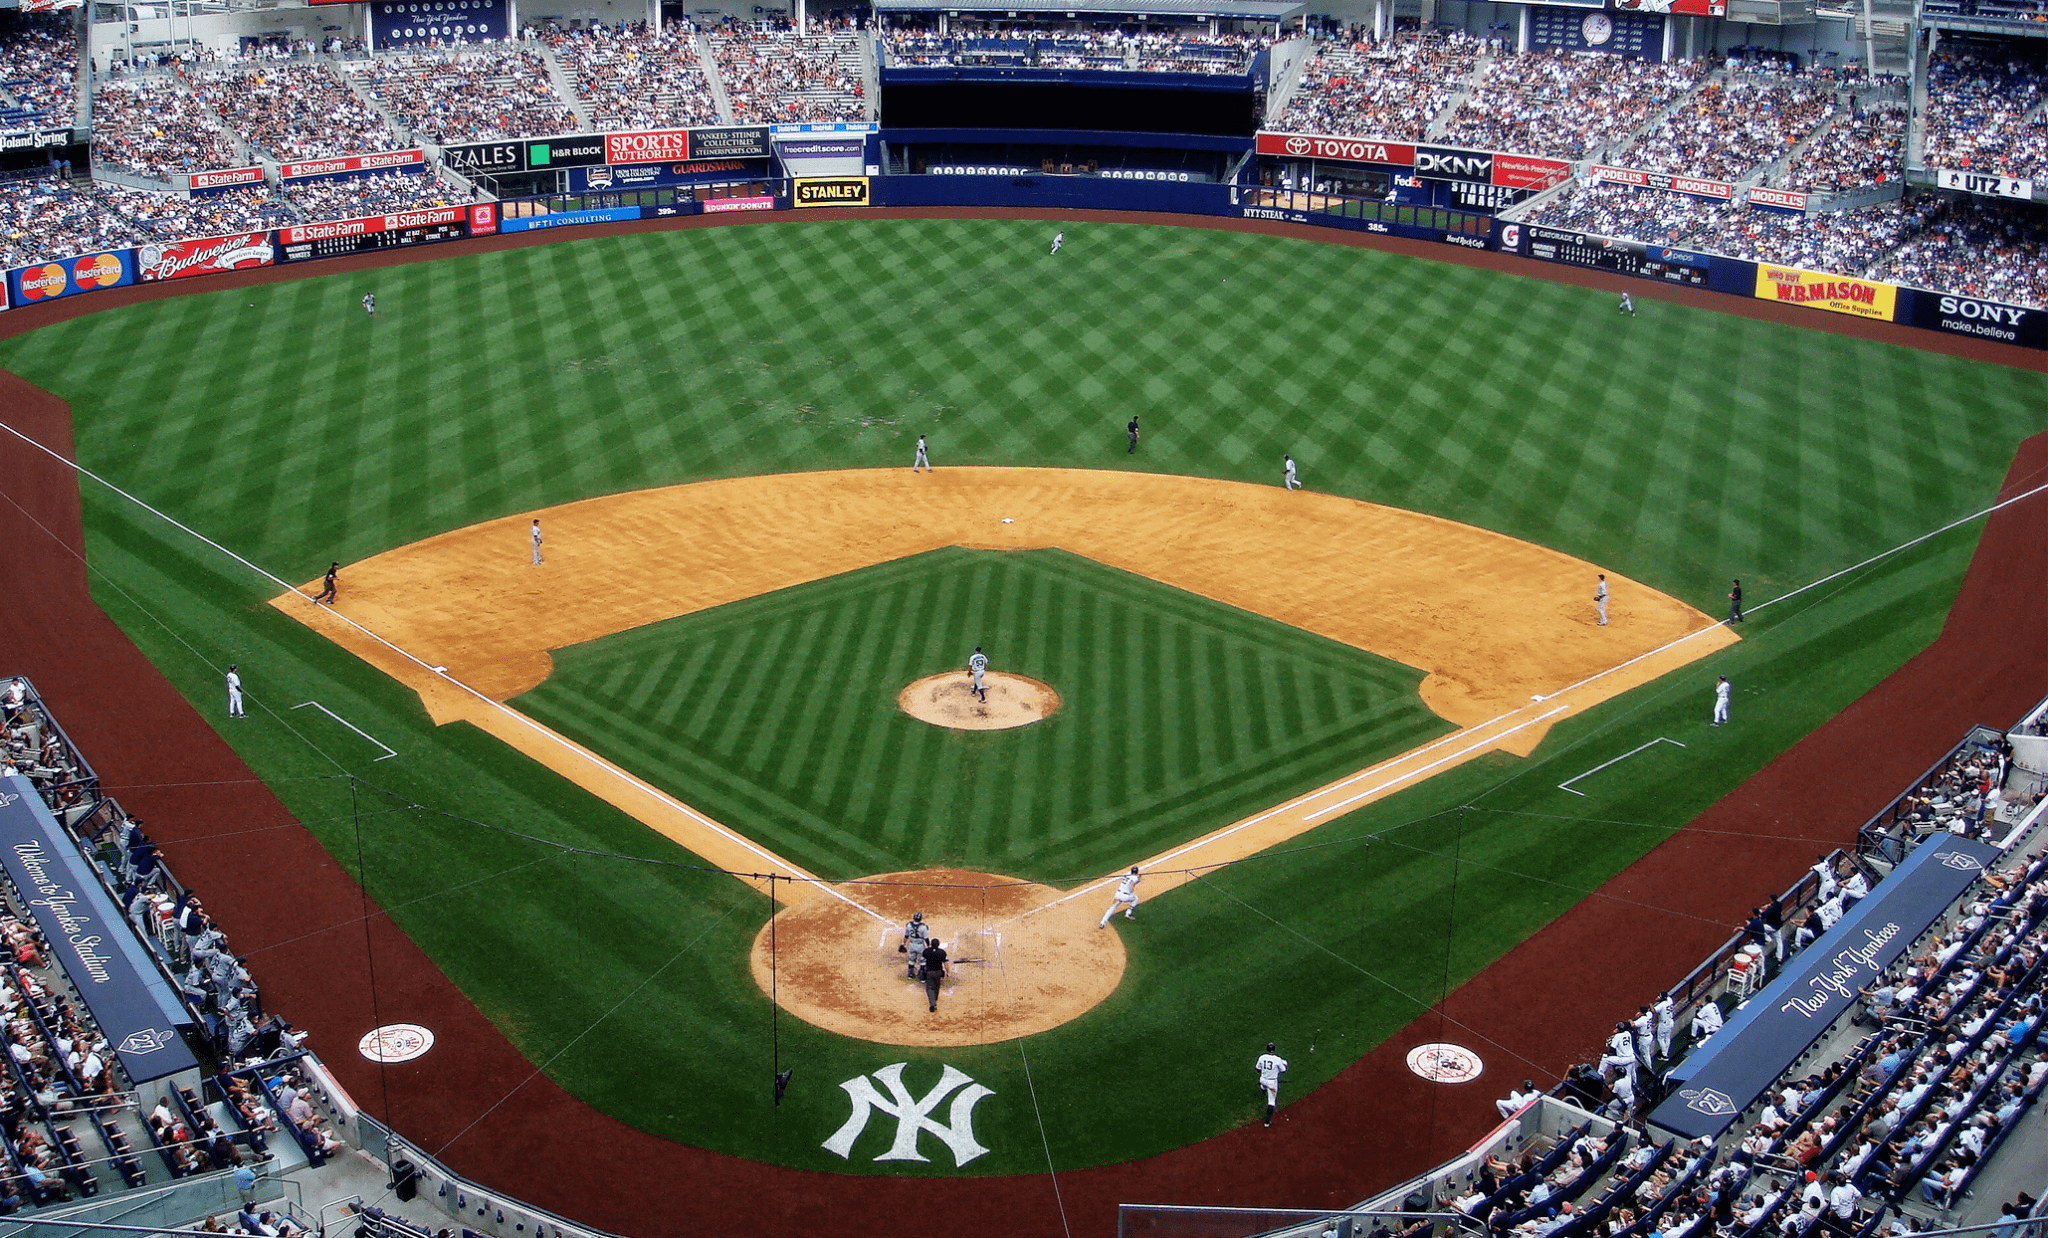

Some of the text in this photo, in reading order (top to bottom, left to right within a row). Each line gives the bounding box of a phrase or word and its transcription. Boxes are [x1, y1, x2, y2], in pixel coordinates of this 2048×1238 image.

[34, 132, 68, 148] Spring
[610, 133, 683, 152] SPORTS
[703, 139, 754, 147] COLLECTIBLES
[453, 146, 516, 168] ZALES
[552, 147, 601, 158] H&R BLOCK
[784, 145, 859, 153] freecreditscore.com
[1314, 140, 1389, 161] TOYOTA
[672, 161, 745, 175] GUARDSMARK
[1416, 153, 1492, 176] DKNY
[1394, 175, 1422, 188] FedEx
[1676, 180, 1727, 196] MODELL'S
[1965, 174, 2001, 194] UTZ
[802, 185, 861, 199] STANLEY
[1451, 182, 1512, 198] SHARPER
[1751, 190, 1804, 207] MODELL'S
[556, 214, 612, 225] CONSULTING
[1243, 208, 1261, 218] NYY
[1261, 210, 1284, 220] STEAK
[1539, 230, 1574, 242] GATORADE
[152, 235, 252, 280] Budweiser
[1672, 252, 1694, 262] pepsi
[75, 264, 121, 280] MasterCard
[1766, 270, 1783, 281] WHO
[23, 274, 66, 291] MasterCard
[1829, 300, 1883, 317] Office Supplies
[1939, 296, 2026, 326] SONY
[1942, 318, 2015, 340] make.believe
[13, 839, 112, 983] Welcome to Yankee Stadium
[1780, 922, 1900, 1018] New York Yankees
[1263, 1060, 1273, 1071] 13
